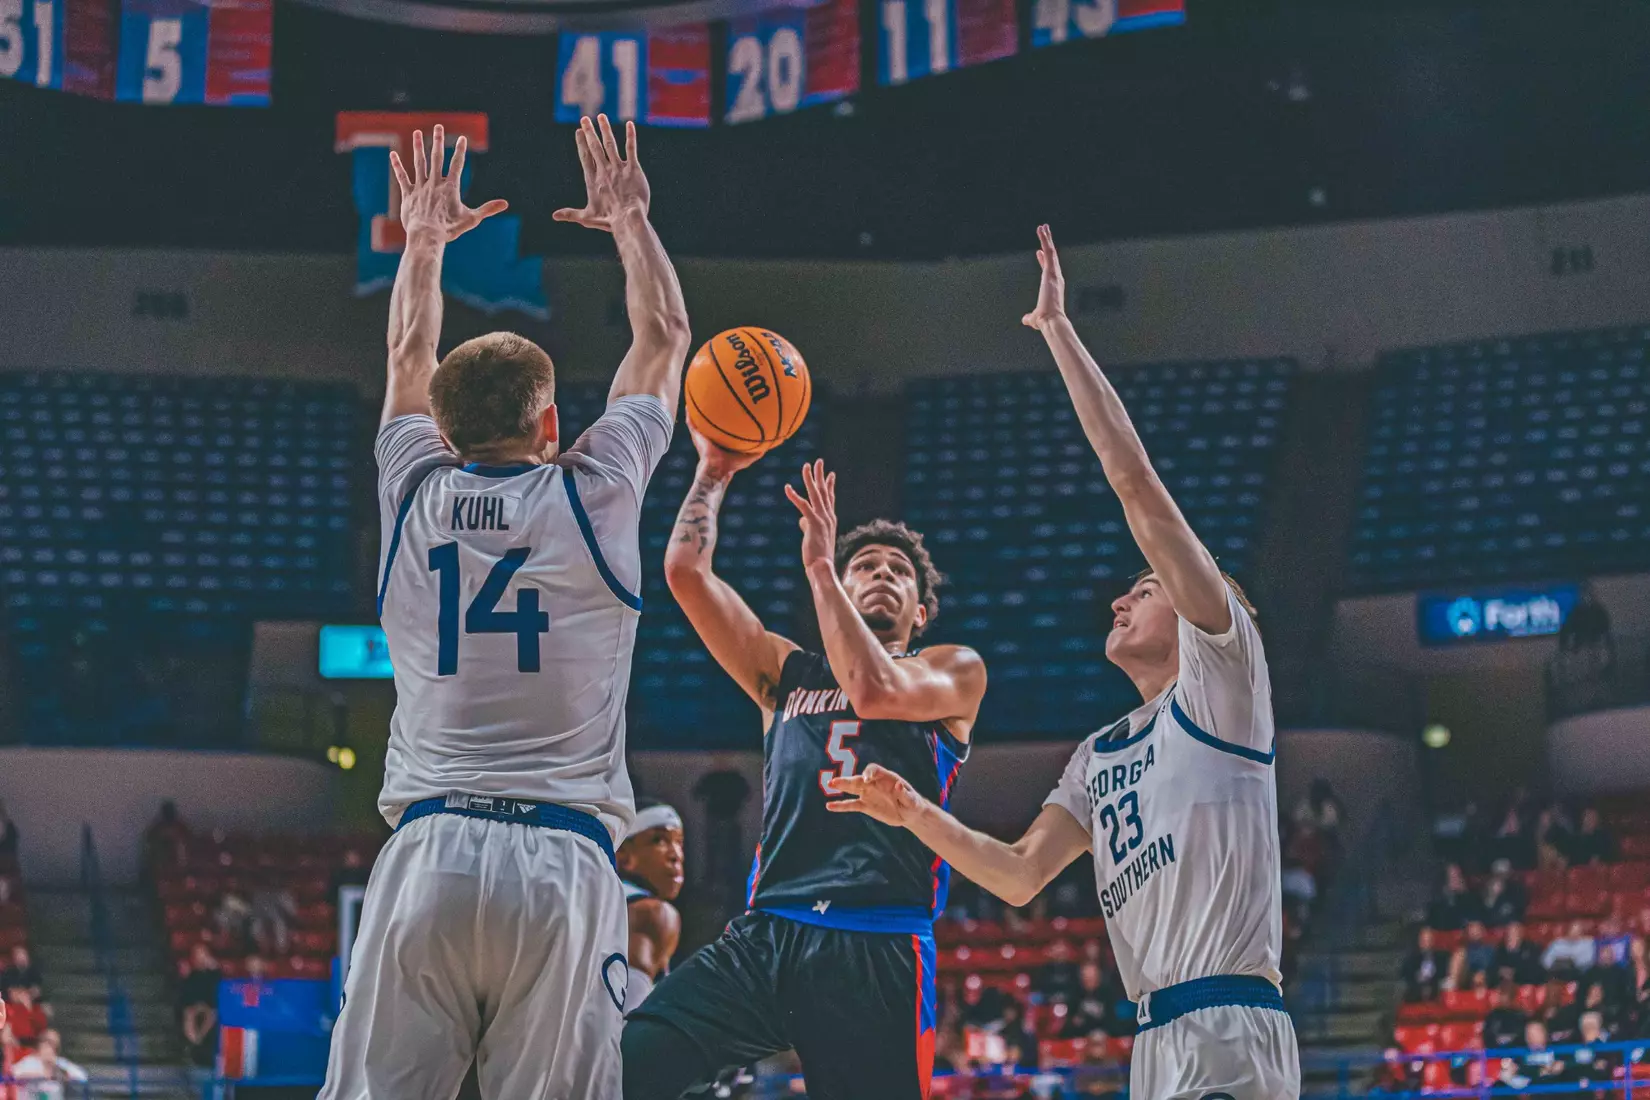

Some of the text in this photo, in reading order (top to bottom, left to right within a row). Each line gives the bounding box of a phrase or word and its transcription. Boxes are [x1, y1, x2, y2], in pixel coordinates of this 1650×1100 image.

[142, 19, 182, 104] 5
[561, 36, 639, 121] 41
[725, 27, 803, 124] 20
[883, 0, 949, 85] 11
[726, 333, 770, 405] Wilson
[451, 496, 510, 531] KUHL
[428, 541, 550, 676] 14
[819, 720, 861, 797] 5
[1087, 744, 1155, 814] EORGA
[1099, 790, 1144, 866] 23
[1100, 833, 1176, 919] SOUTHERN
